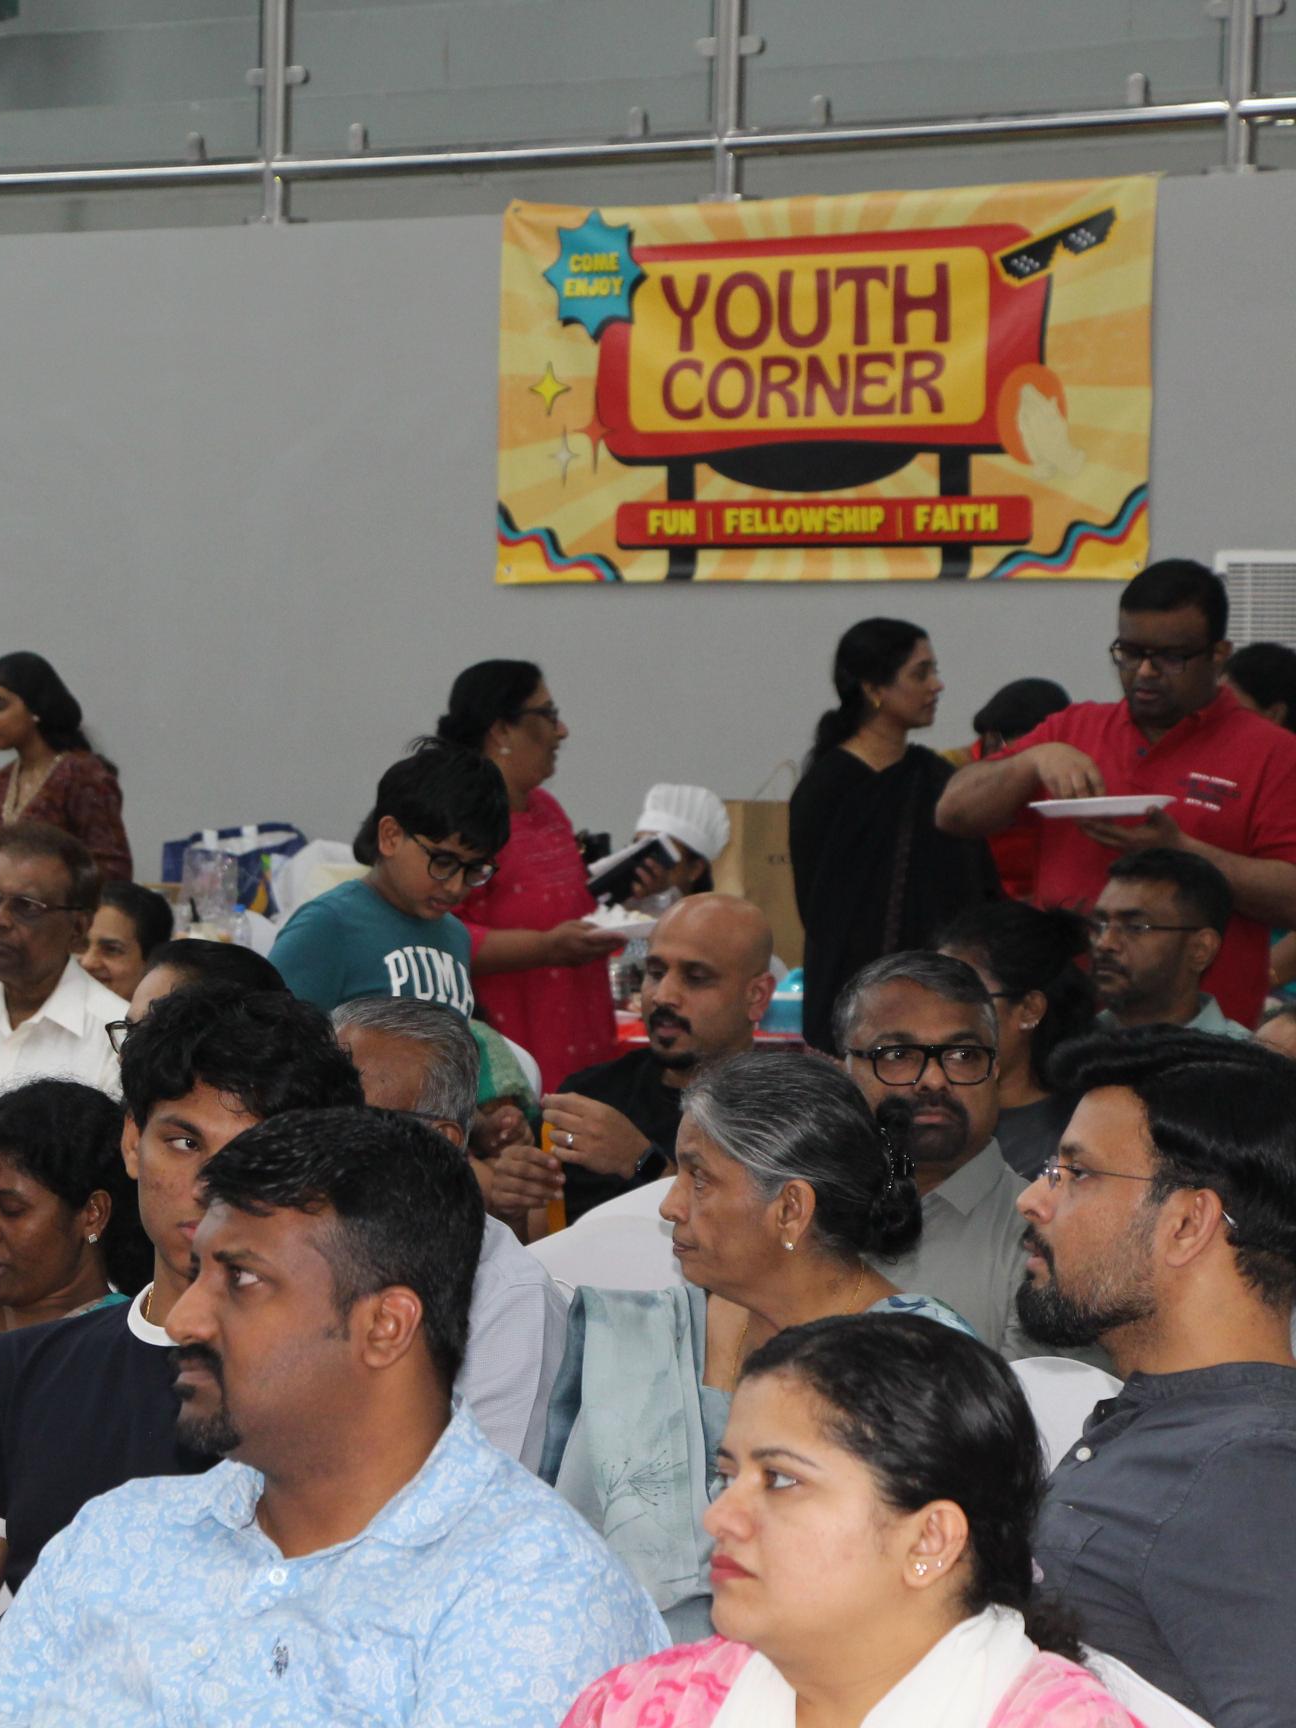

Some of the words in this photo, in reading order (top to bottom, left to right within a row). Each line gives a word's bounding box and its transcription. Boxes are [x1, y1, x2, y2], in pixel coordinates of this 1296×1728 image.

[564, 277, 625, 297] ENJOY
[569, 253, 621, 273] COME
[660, 262, 951, 352] YOUTH
[661, 349, 946, 421] CORNER
[647, 508, 697, 535] FUN
[723, 505, 886, 535] FELLOWSHIP
[913, 503, 999, 532] FAITH
[383, 945, 475, 1022] PUMA
